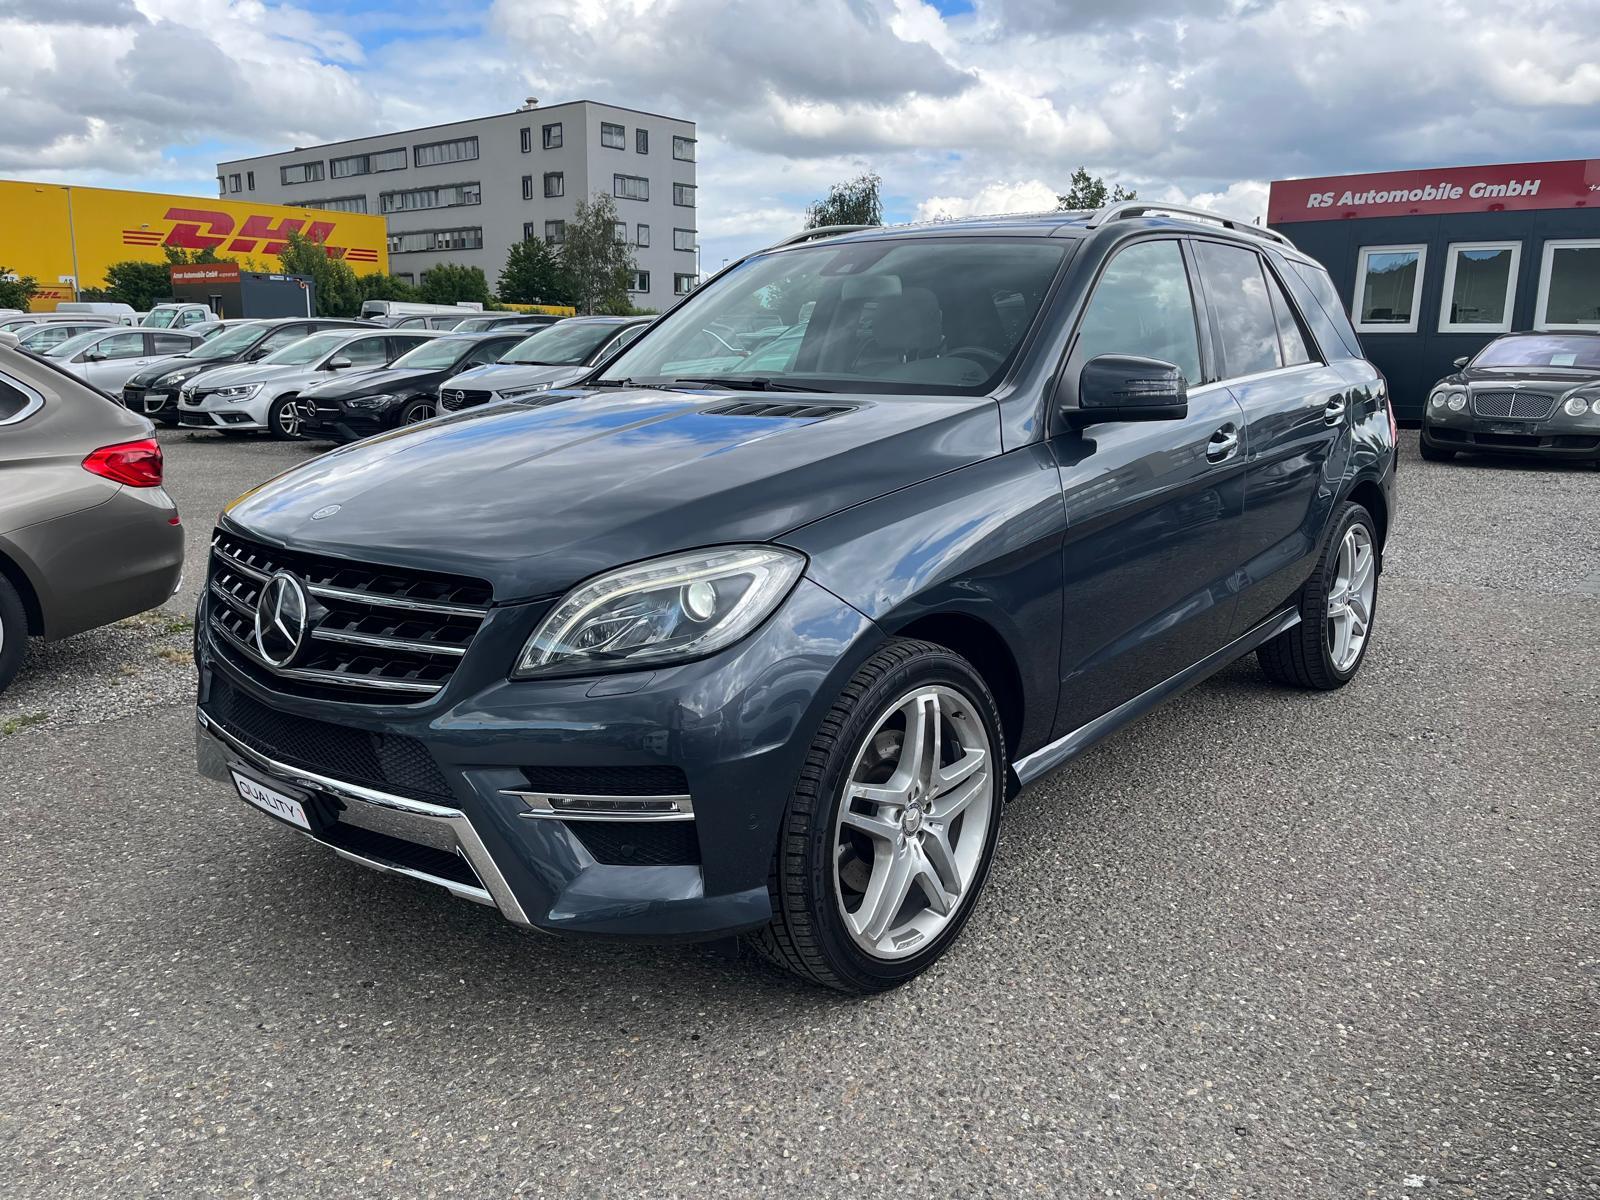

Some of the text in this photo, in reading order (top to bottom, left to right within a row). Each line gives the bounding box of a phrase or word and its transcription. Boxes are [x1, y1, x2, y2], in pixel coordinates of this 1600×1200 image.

[1307, 180, 1541, 208] RS Automobile GmbH
[163, 208, 347, 259] DHL
[240, 781, 294, 817] QUALITY
